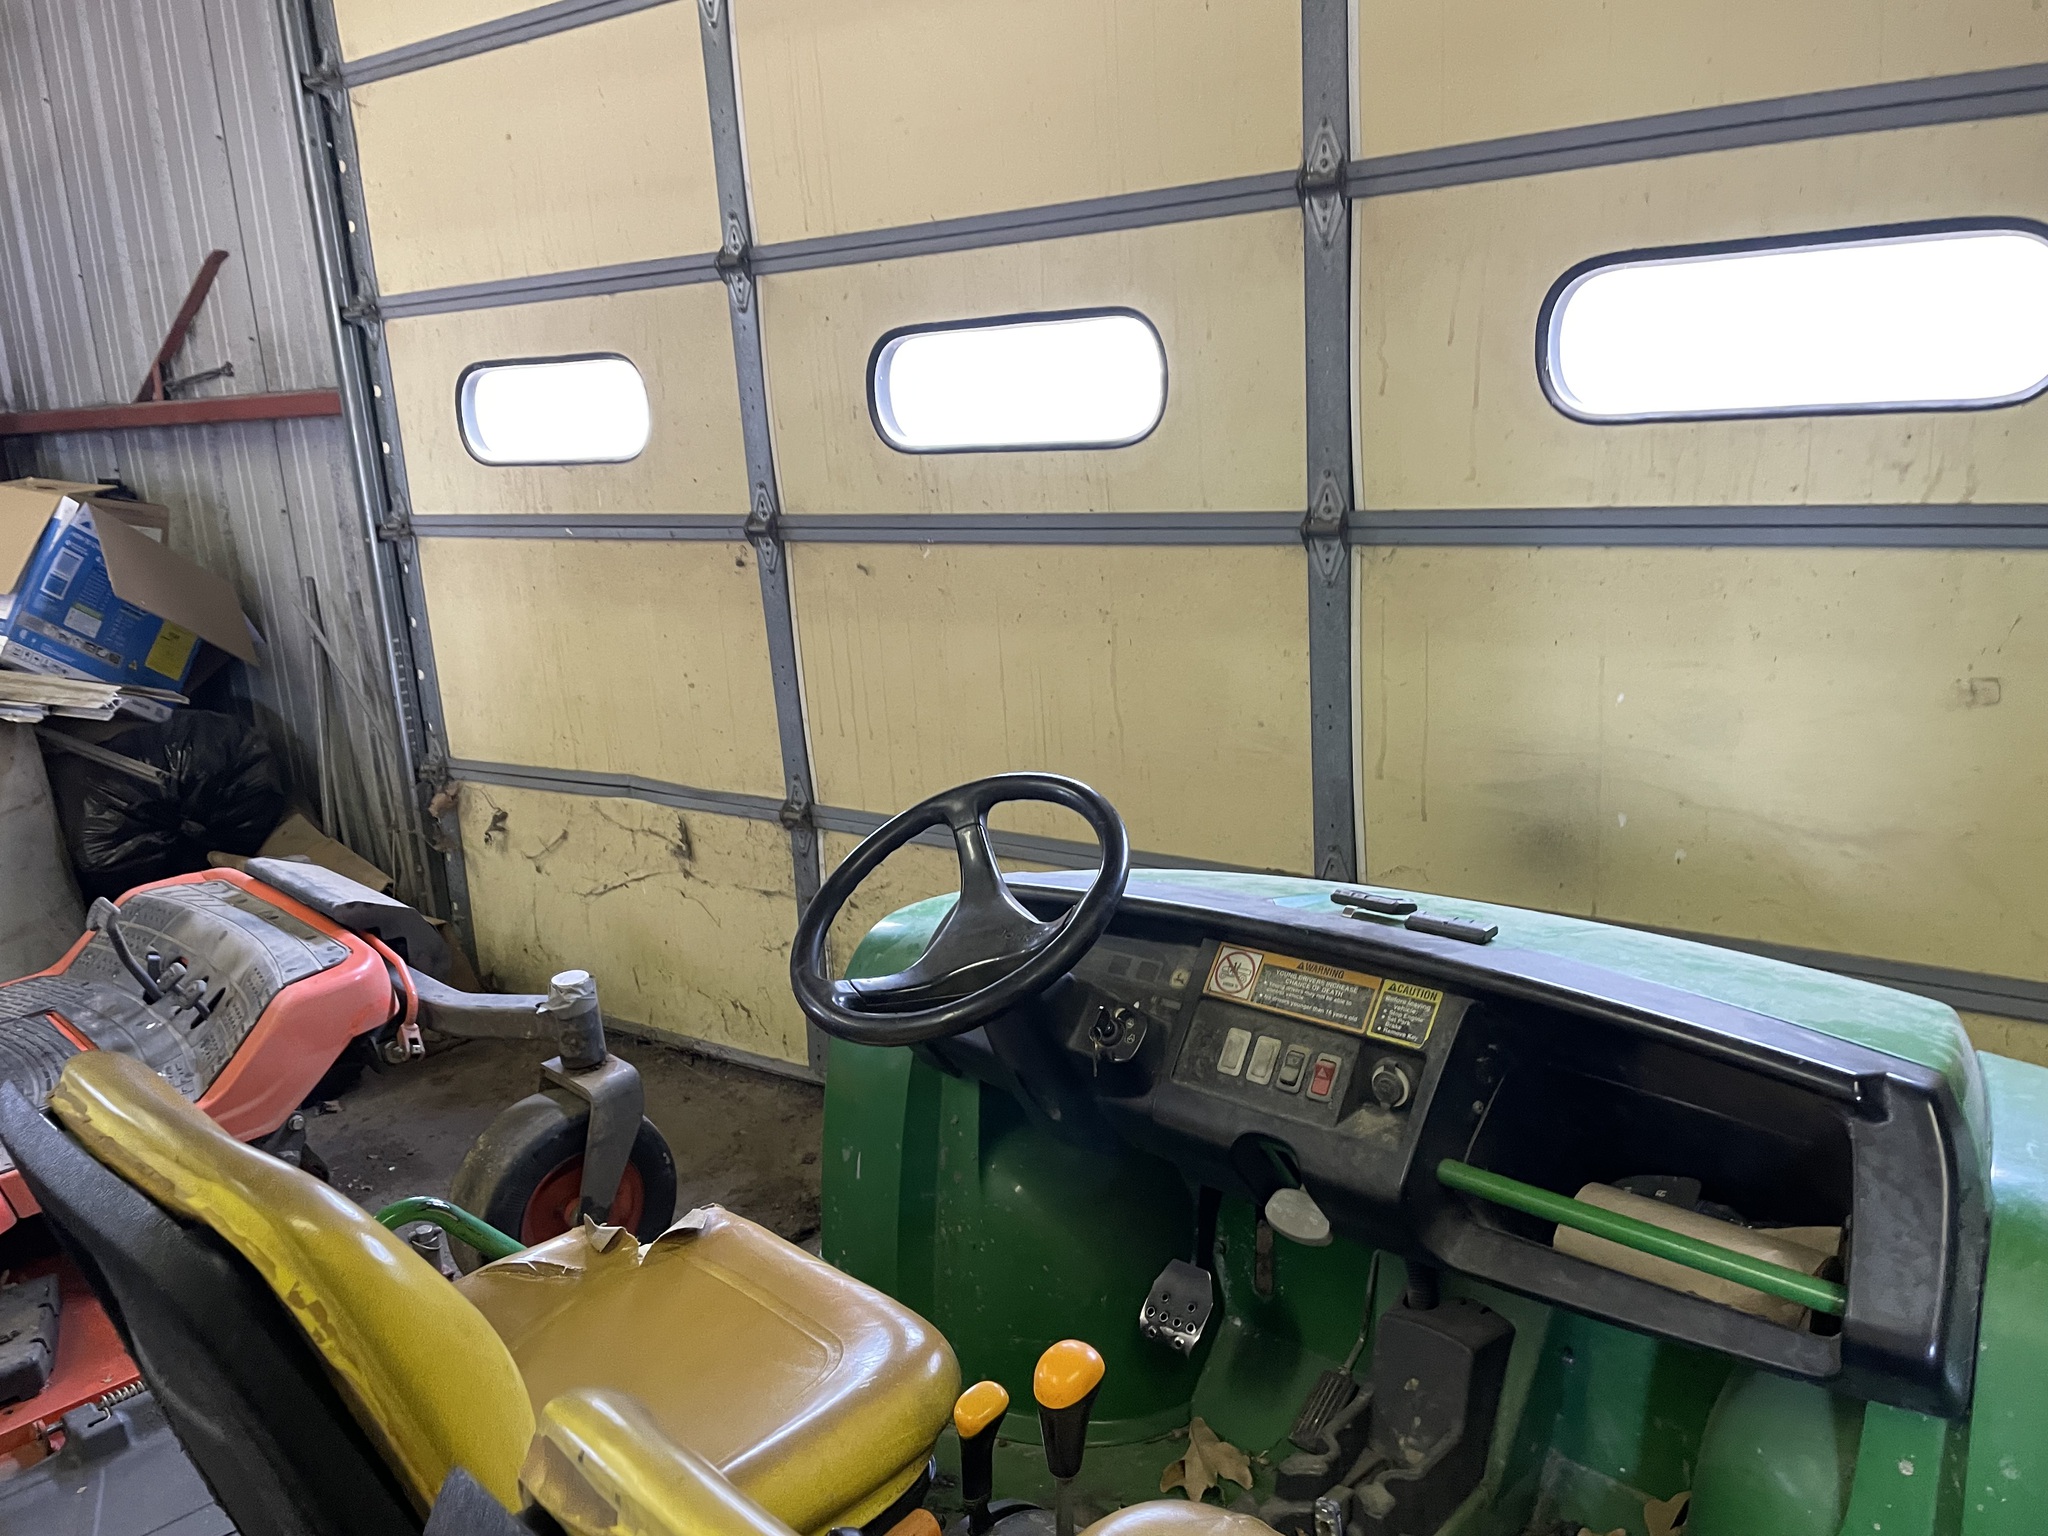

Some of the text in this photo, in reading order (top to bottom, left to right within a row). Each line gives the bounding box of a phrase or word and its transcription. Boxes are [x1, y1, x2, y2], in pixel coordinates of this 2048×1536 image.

[1305, 962, 1345, 979] WARNING
[1276, 969, 1360, 994] YOUNG DRIVERS INCREASE
[1285, 978, 1344, 998] CHANCE OF DEATH
[1397, 983, 1438, 1001] CAUTION
